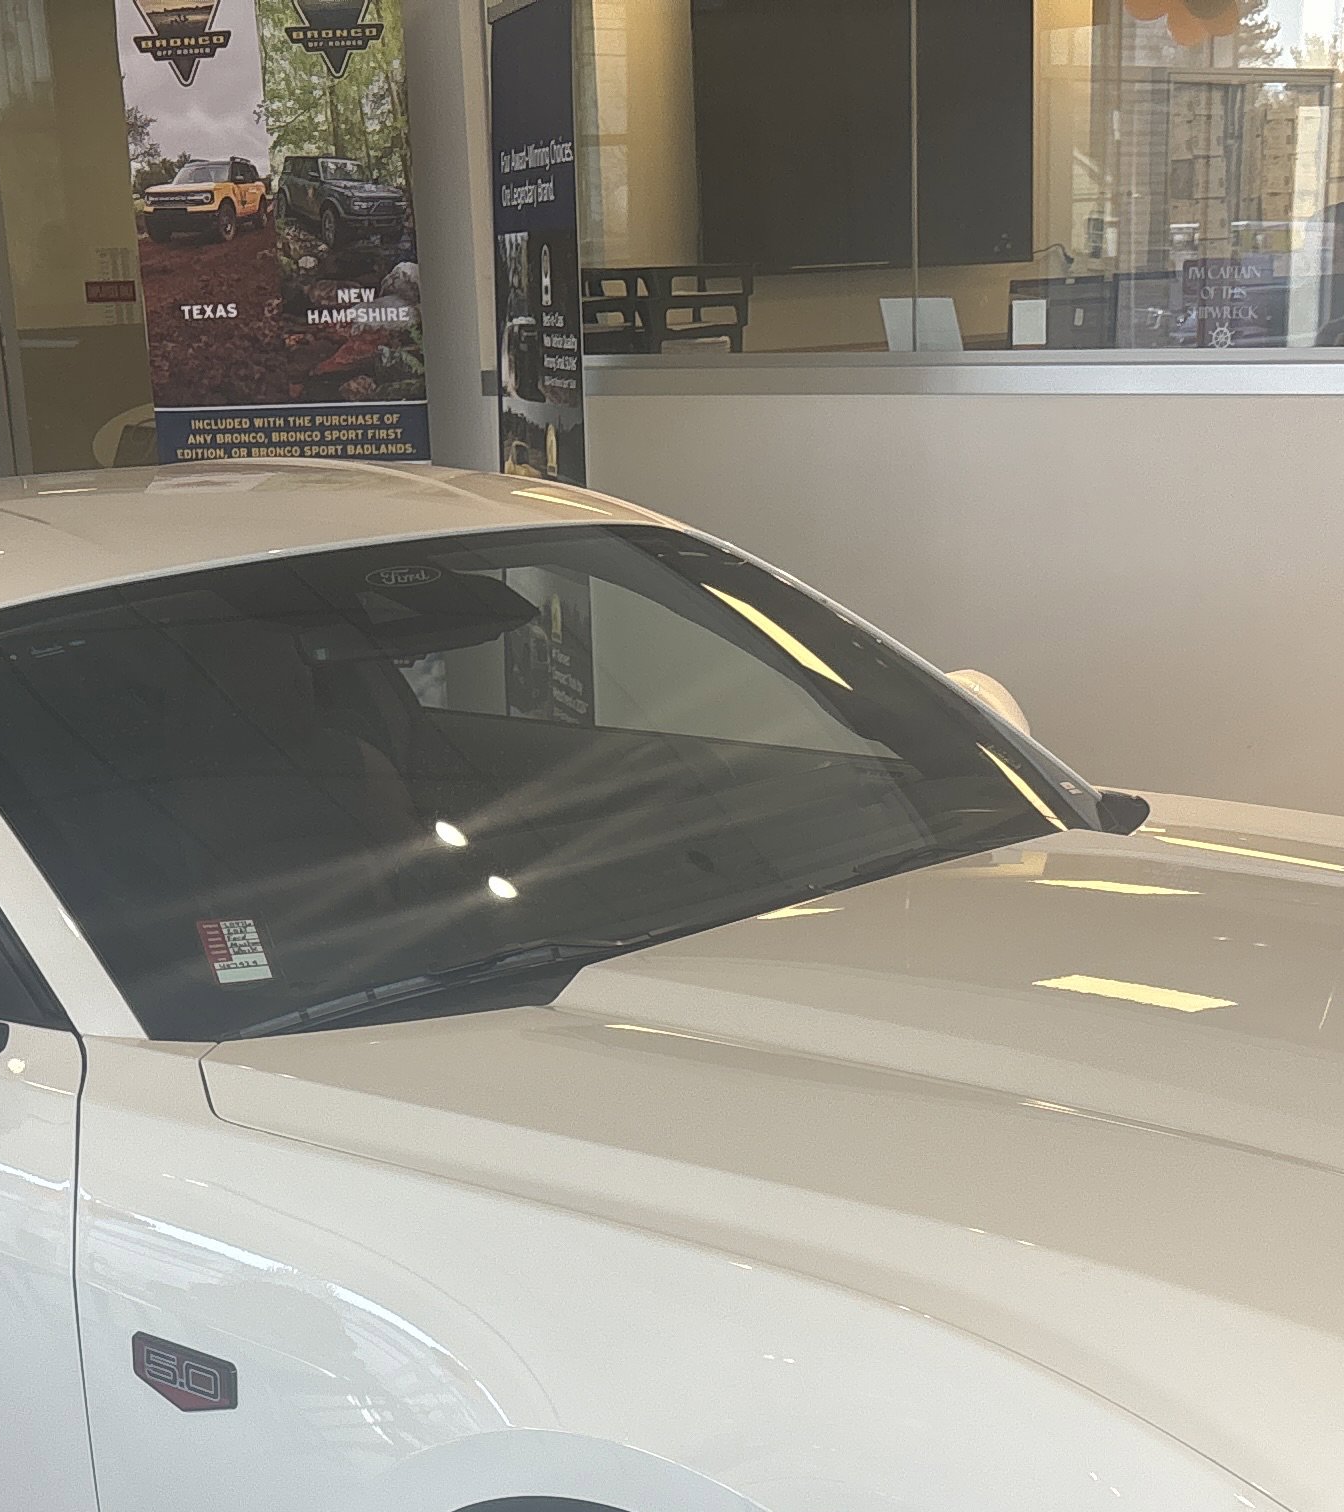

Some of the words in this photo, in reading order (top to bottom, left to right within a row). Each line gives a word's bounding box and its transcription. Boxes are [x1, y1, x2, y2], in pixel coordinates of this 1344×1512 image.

[141, 35, 225, 49] BRONCO
[293, 27, 377, 40] BRONCO
[1207, 265, 1261, 279] CAPTAIN
[337, 287, 376, 304] NEW
[1200, 286, 1216, 299] OF
[1222, 285, 1247, 299] THIS
[181, 303, 238, 320] TEXAS
[307, 306, 411, 324] HAMPSHIRE
[191, 418, 251, 431] INCLUDED
[254, 416, 284, 428] WITH
[288, 415, 312, 427] THE
[316, 413, 381, 426] PURCHASE
[384, 413, 401, 424] OF
[187, 433, 212, 445] ANY
[216, 431, 268, 444] BRONCO,
[272, 430, 321, 442] BRONCO
[324, 428, 364, 441] SPORT
[368, 428, 403, 440] FIRST
[177, 447, 228, 460] EDITION,
[232, 446, 248, 458] OR
[252, 445, 301, 457] BRONCO
[304, 444, 343, 456] SPORT
[347, 442, 416, 456] BADLANDS.
[379, 568, 431, 586] Ford
[144, 1345, 221, 1402] 5.0
